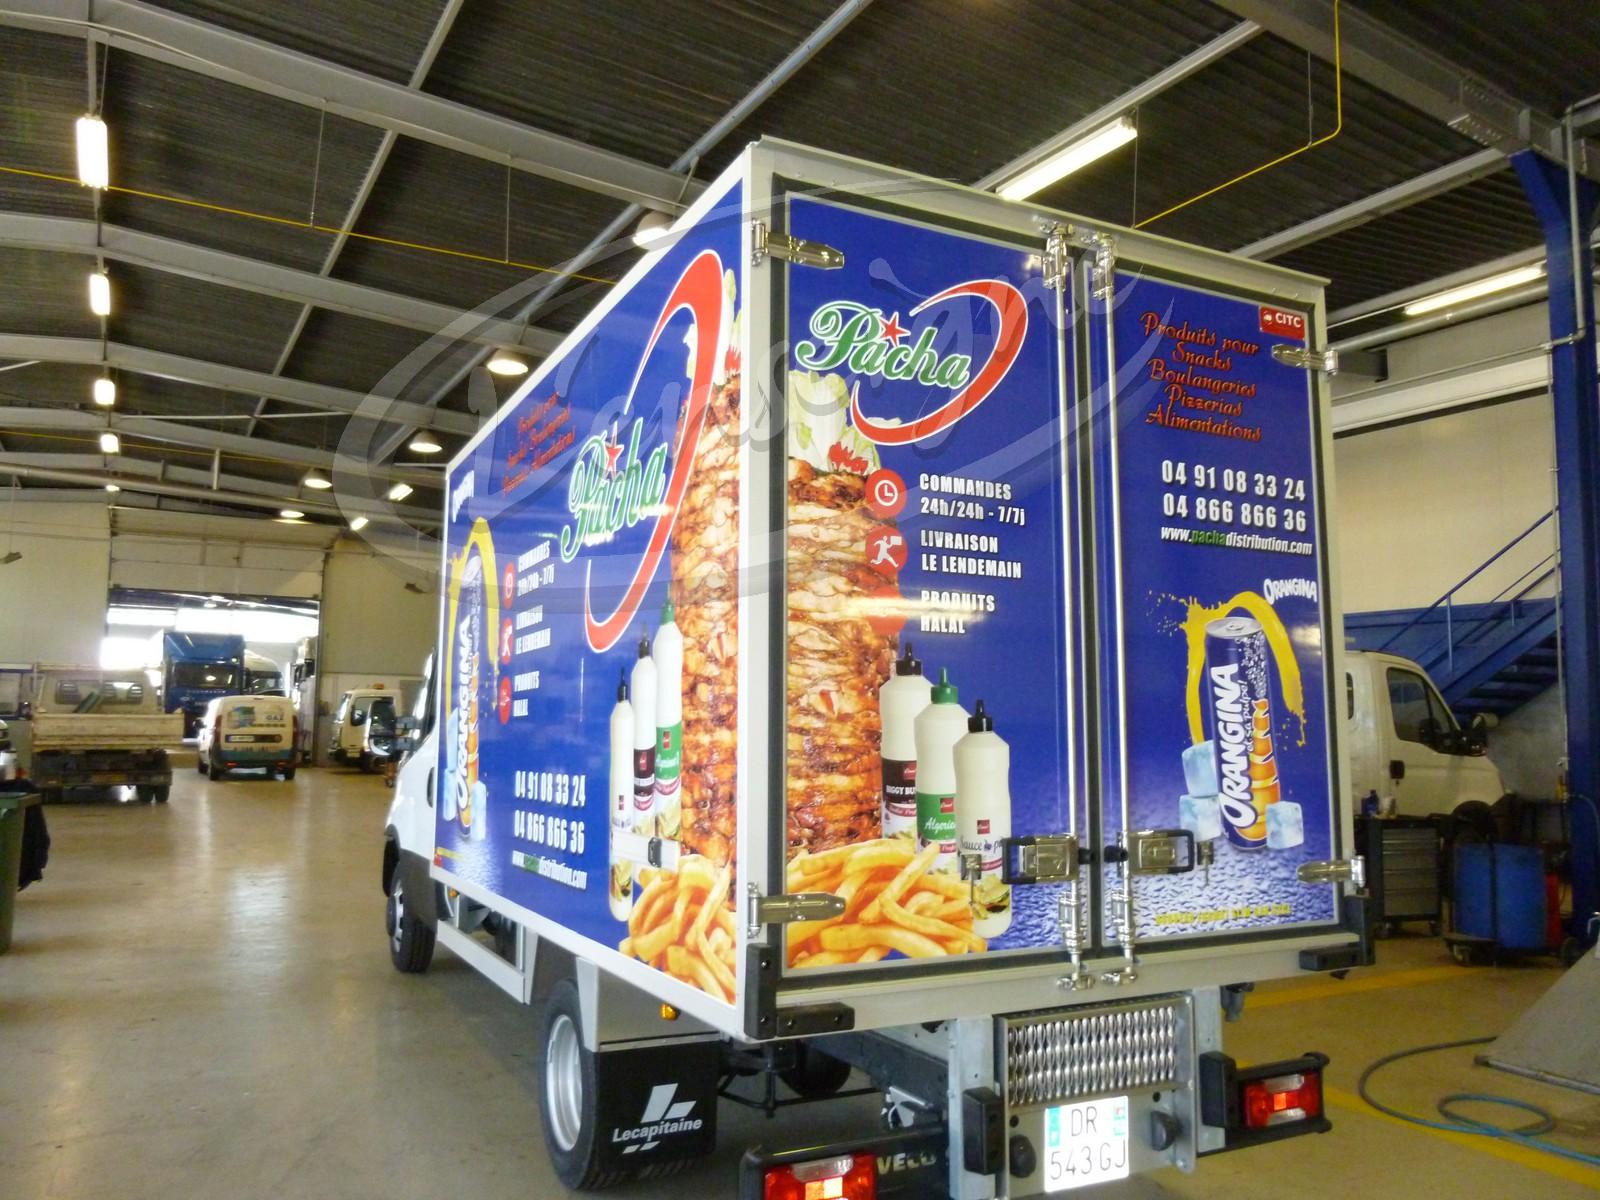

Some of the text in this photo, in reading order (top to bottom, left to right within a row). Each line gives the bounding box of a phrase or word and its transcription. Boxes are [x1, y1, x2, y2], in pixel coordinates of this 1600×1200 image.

[1139, 312, 1260, 355] Produits pour
[1275, 312, 1302, 328] CITC
[795, 300, 972, 389] Pacha
[1172, 340, 1233, 371] Snacks
[1147, 358, 1257, 398] Boulangeries
[1164, 383, 1244, 417] Pizzerias
[1145, 403, 1262, 441] Alimentations
[560, 416, 669, 563] Pacha
[920, 473, 1012, 500] COMMANDES
[1162, 459, 1305, 501] 04 91 08 33 24
[921, 497, 984, 520] 24h/24h
[998, 505, 1025, 526] 7/7j
[1163, 492, 1306, 532] 04 866 866 36
[921, 529, 998, 553] LIVRAISON
[1161, 526, 1313, 555] www.pachadistribution.com
[922, 553, 1022, 579] LE LENDEMAIN
[921, 590, 995, 612] PRODUITS
[1264, 577, 1318, 605] ORANGINA
[921, 615, 965, 634] HALAL
[1210, 663, 1256, 828] ORANGINA
[515, 770, 586, 807] 04 91 08 33 24
[514, 809, 585, 854] 04 866 866 36
[612, 1118, 703, 1142] Lecapitaine
[1071, 1105, 1098, 1137] DR
[1050, 1139, 1126, 1181] 543 GJ
